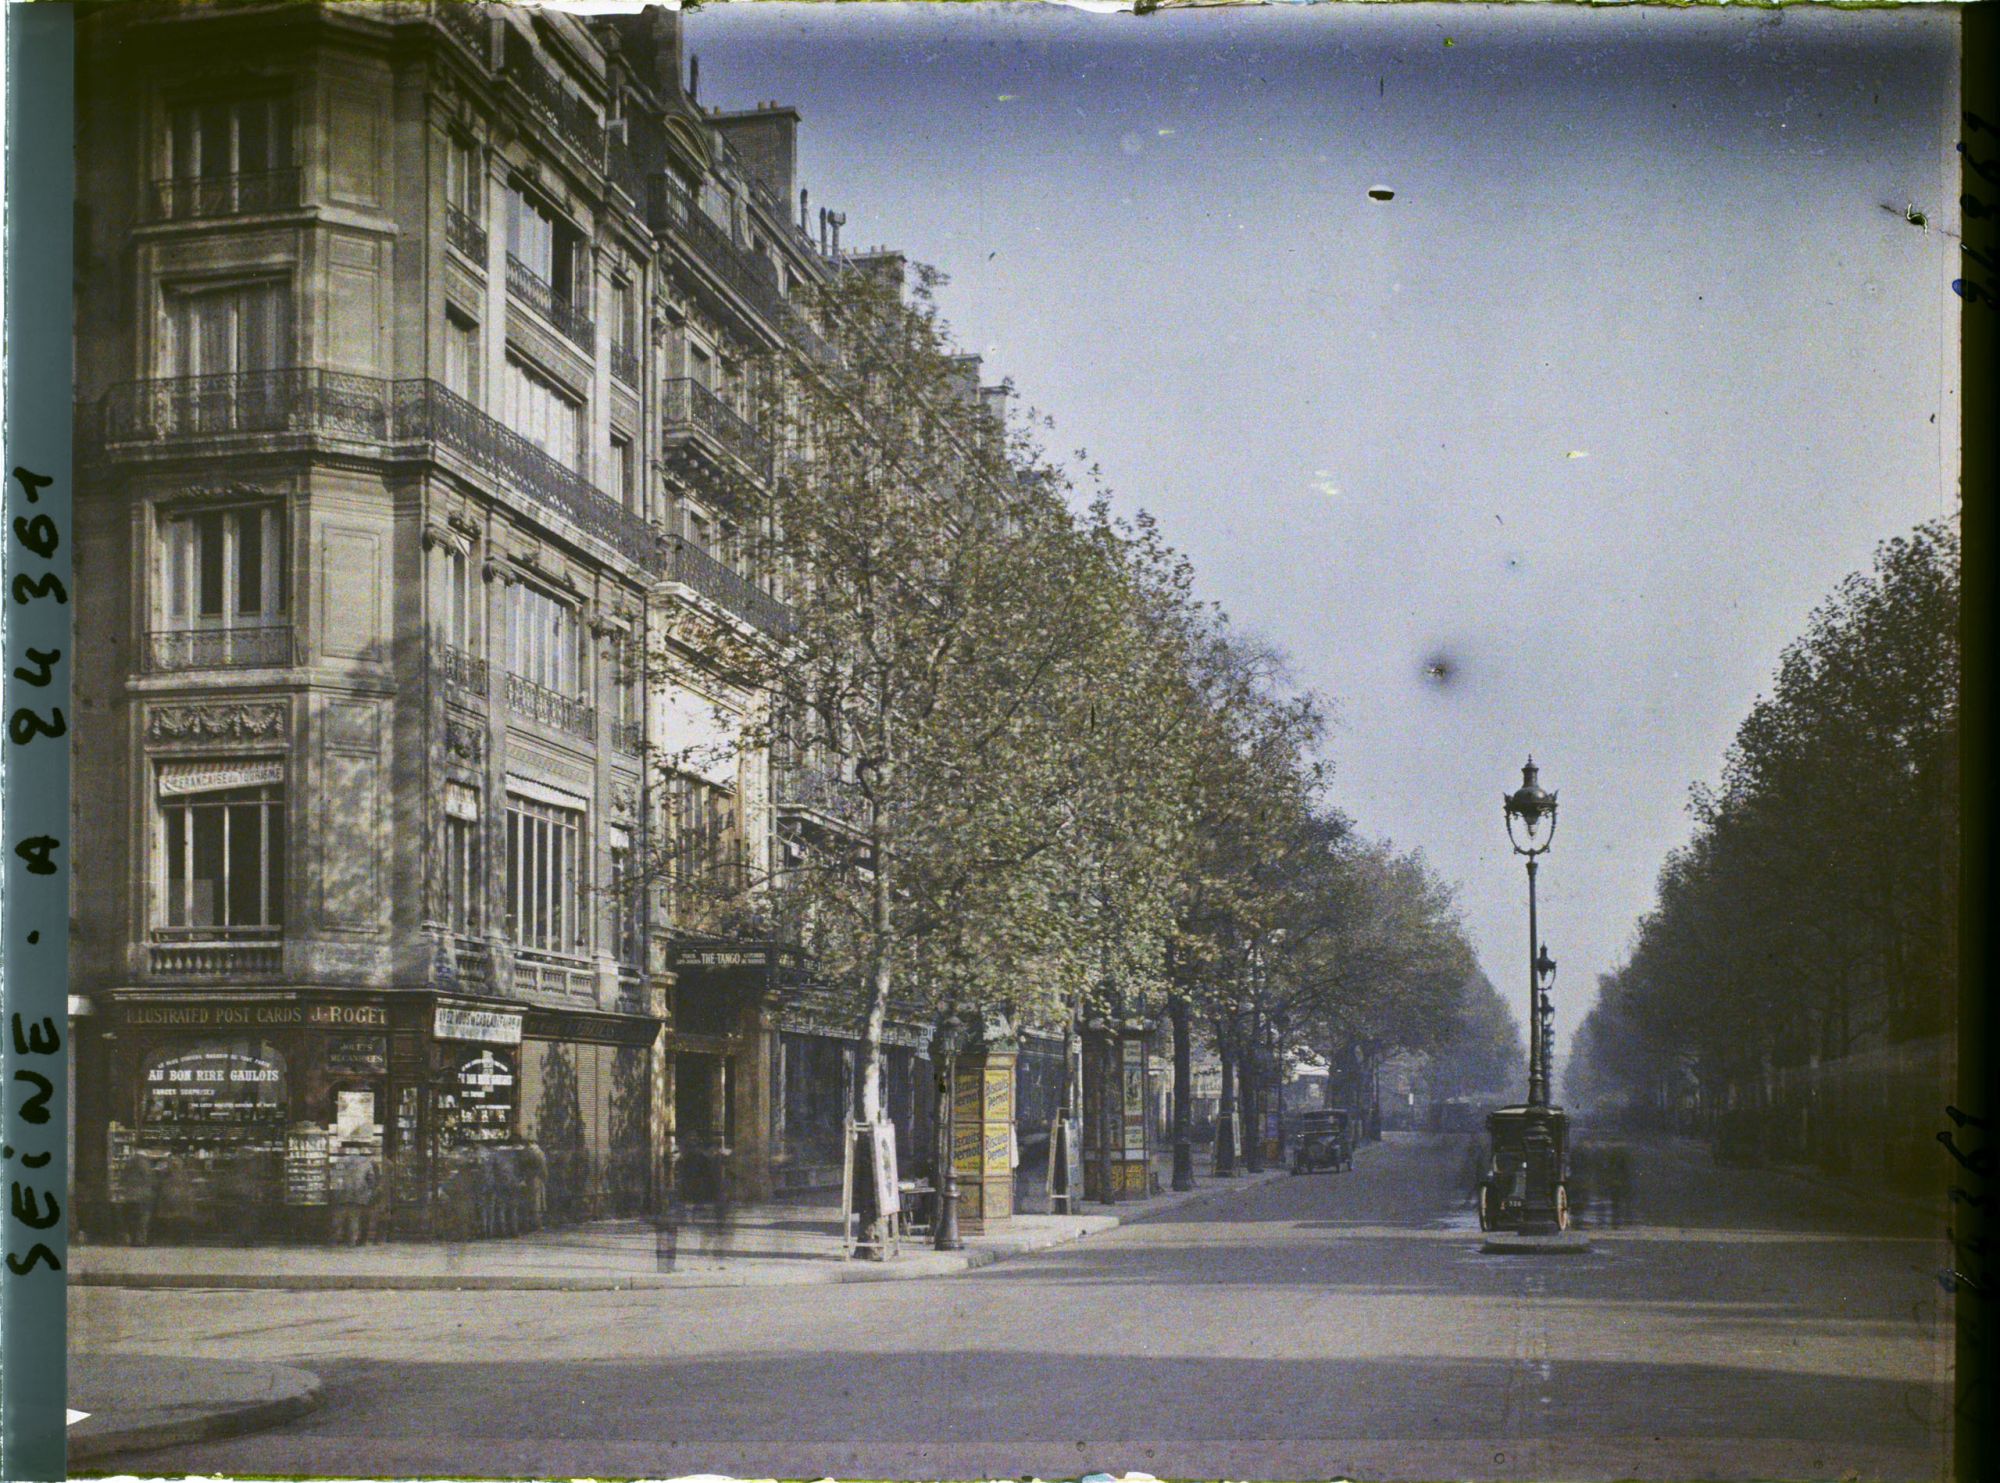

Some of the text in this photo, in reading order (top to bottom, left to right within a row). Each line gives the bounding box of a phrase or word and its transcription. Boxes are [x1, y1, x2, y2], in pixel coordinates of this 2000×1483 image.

[14, 834, 60, 875] A
[126, 1007, 302, 1023] ILLUSTRATED POST CARDS
[147, 1069, 279, 1081] AU BON RIRE GAULOIS
